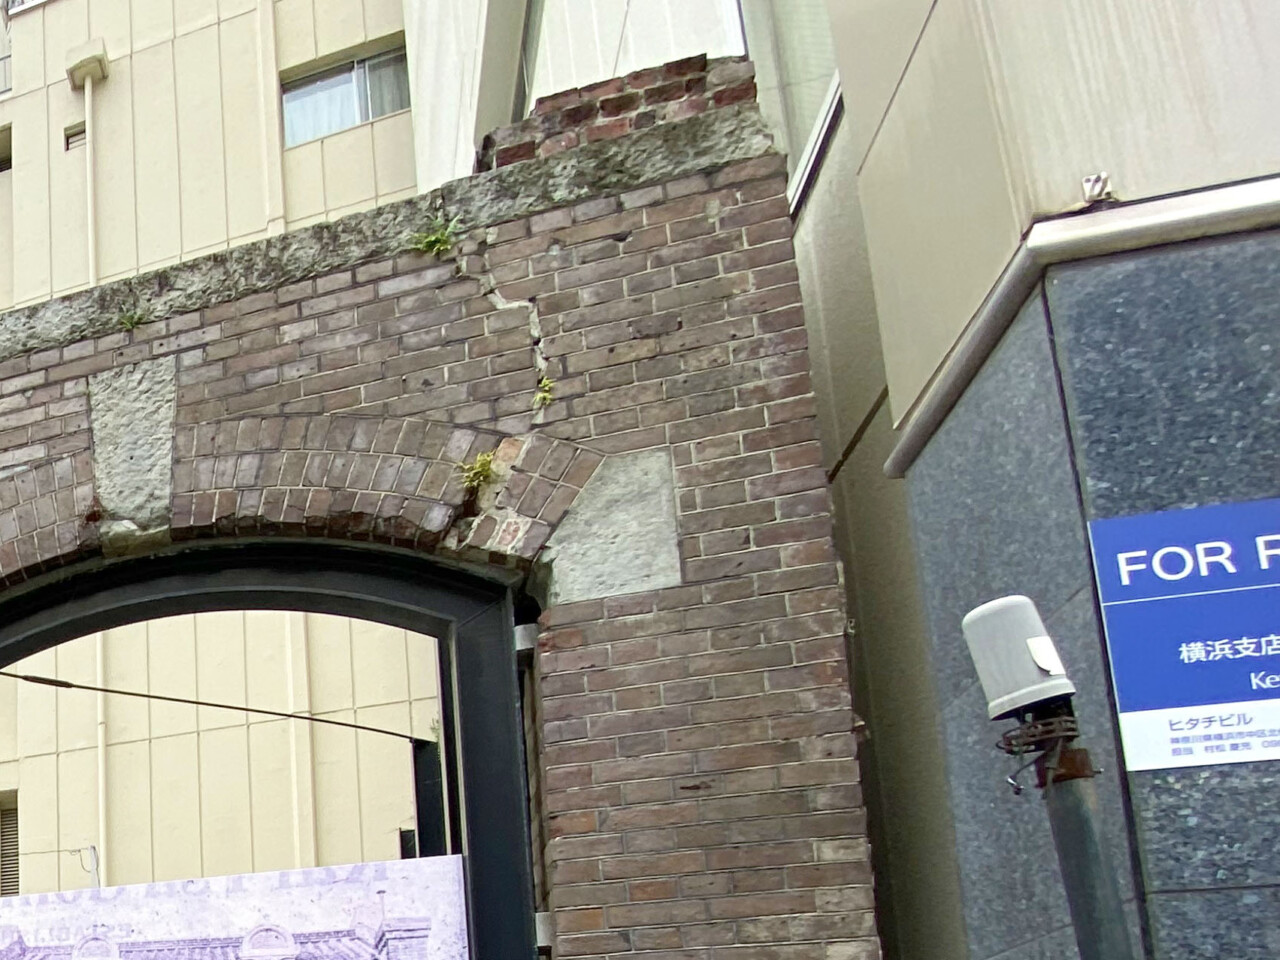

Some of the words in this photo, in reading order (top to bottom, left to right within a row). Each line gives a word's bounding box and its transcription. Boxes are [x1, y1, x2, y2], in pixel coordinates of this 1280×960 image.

[1117, 541, 1237, 586] FOR
[1178, 633, 1280, 664] 横浜支店
[1169, 713, 1253, 732] ヒタチビル
